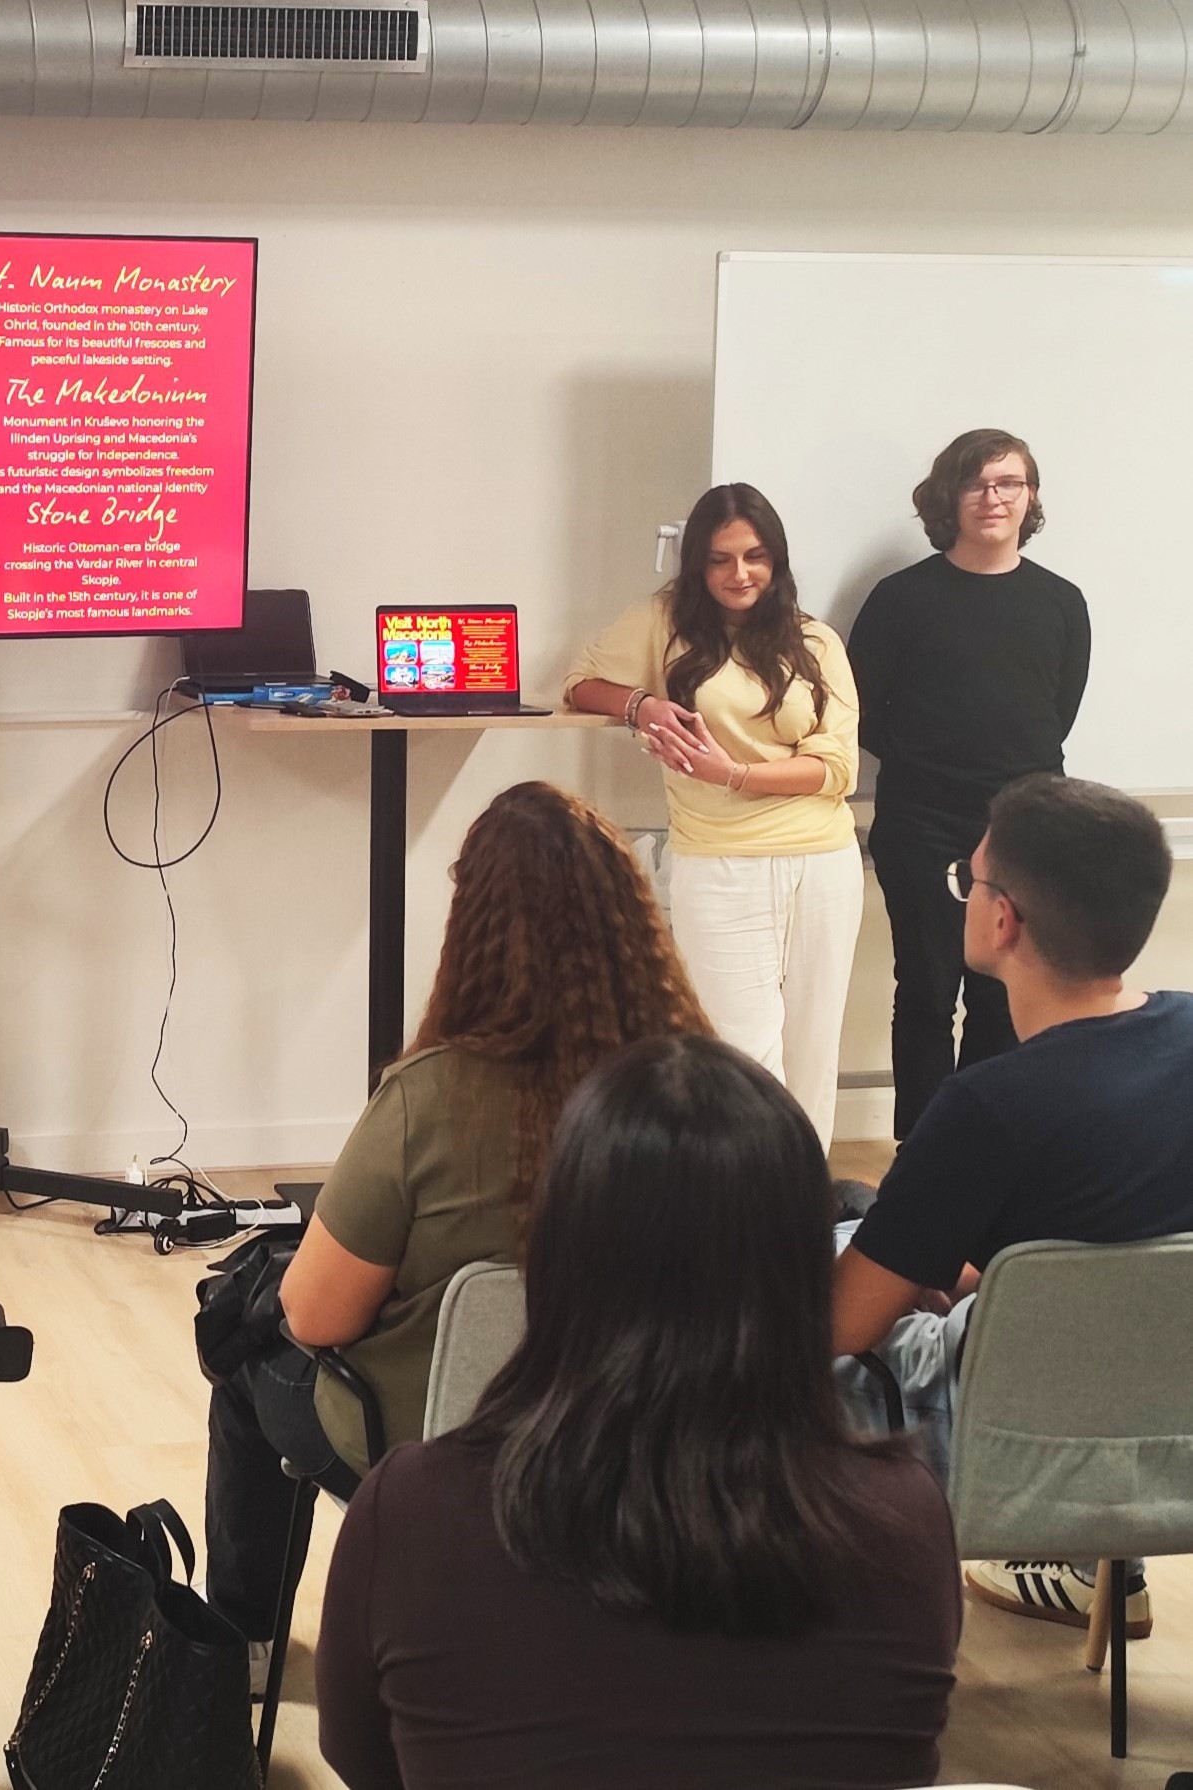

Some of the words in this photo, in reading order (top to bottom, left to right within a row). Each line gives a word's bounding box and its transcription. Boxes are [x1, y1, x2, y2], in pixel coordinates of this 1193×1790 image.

[30, 264, 102, 290] Naum
[114, 265, 238, 297] Monastery
[44, 303, 98, 314] Orthodox
[101, 305, 162, 317] monastery
[164, 306, 179, 315] on
[182, 305, 208, 315] Lake
[4, 319, 40, 331] Ohrid,
[42, 320, 90, 331] founded
[93, 321, 104, 331] in
[107, 321, 126, 331] the
[129, 321, 153, 332] 10th
[155, 322, 201, 334] century.
[47, 337, 63, 347] for
[65, 337, 79, 347] its
[82, 337, 132, 348] beautiful
[135, 337, 182, 349] frescoes
[184, 338, 206, 349] and
[31, 354, 80, 367] peaceful
[83, 353, 129, 365] lakeside
[131, 354, 173, 367] setting.
[6, 378, 46, 407] The
[56, 374, 207, 405] Makedonium
[3, 416, 68, 427] Monument
[71, 416, 81, 427] in
[84, 415, 129, 427] Kruševo
[132, 416, 183, 429] honoring
[186, 416, 205, 427] the
[11, 433, 50, 444] Ilinden
[53, 433, 100, 445] Uprising
[103, 433, 125, 444] and
[128, 432, 197, 444] Macedonia's
[27, 450, 75, 462] struggle
[78, 450, 93, 460] for
[96, 449, 179, 462] independence.
[8, 466, 58, 477] futuristic
[61, 467, 99, 479] design
[102, 466, 164, 479] symbolizes
[166, 466, 214, 476] freedom
[23, 483, 42, 493] the
[45, 483, 114, 493] Macedonian
[117, 482, 162, 493] national
[165, 482, 207, 495] identity
[26, 497, 91, 525] Stone
[101, 494, 178, 542] Bridge
[23, 542, 66, 554] Historic
[69, 542, 141, 553] Ottoman-era
[145, 541, 180, 554] bridge
[4, 559, 51, 572] crossing
[54, 559, 73, 569] the
[76, 558, 113, 569] Vardar
[116, 558, 142, 568] River
[146, 557, 156, 568] in
[159, 557, 198, 568] central
[81, 575, 122, 587] Skopje.
[3, 593, 30, 603] Built
[33, 592, 44, 603] in
[46, 592, 65, 602] the
[68, 591, 90, 602] 15th
[93, 591, 138, 603] century,
[141, 590, 149, 600] it
[152, 590, 161, 600] is
[162, 591, 183, 600] one
[186, 589, 198, 600] of
[7, 609, 53, 621] Skopje's
[56, 608, 84, 618] most
[87, 607, 129, 617] famous
[132, 605, 193, 617] landmarks.
[385, 616, 413, 629] Visit
[416, 616, 451, 629] North
